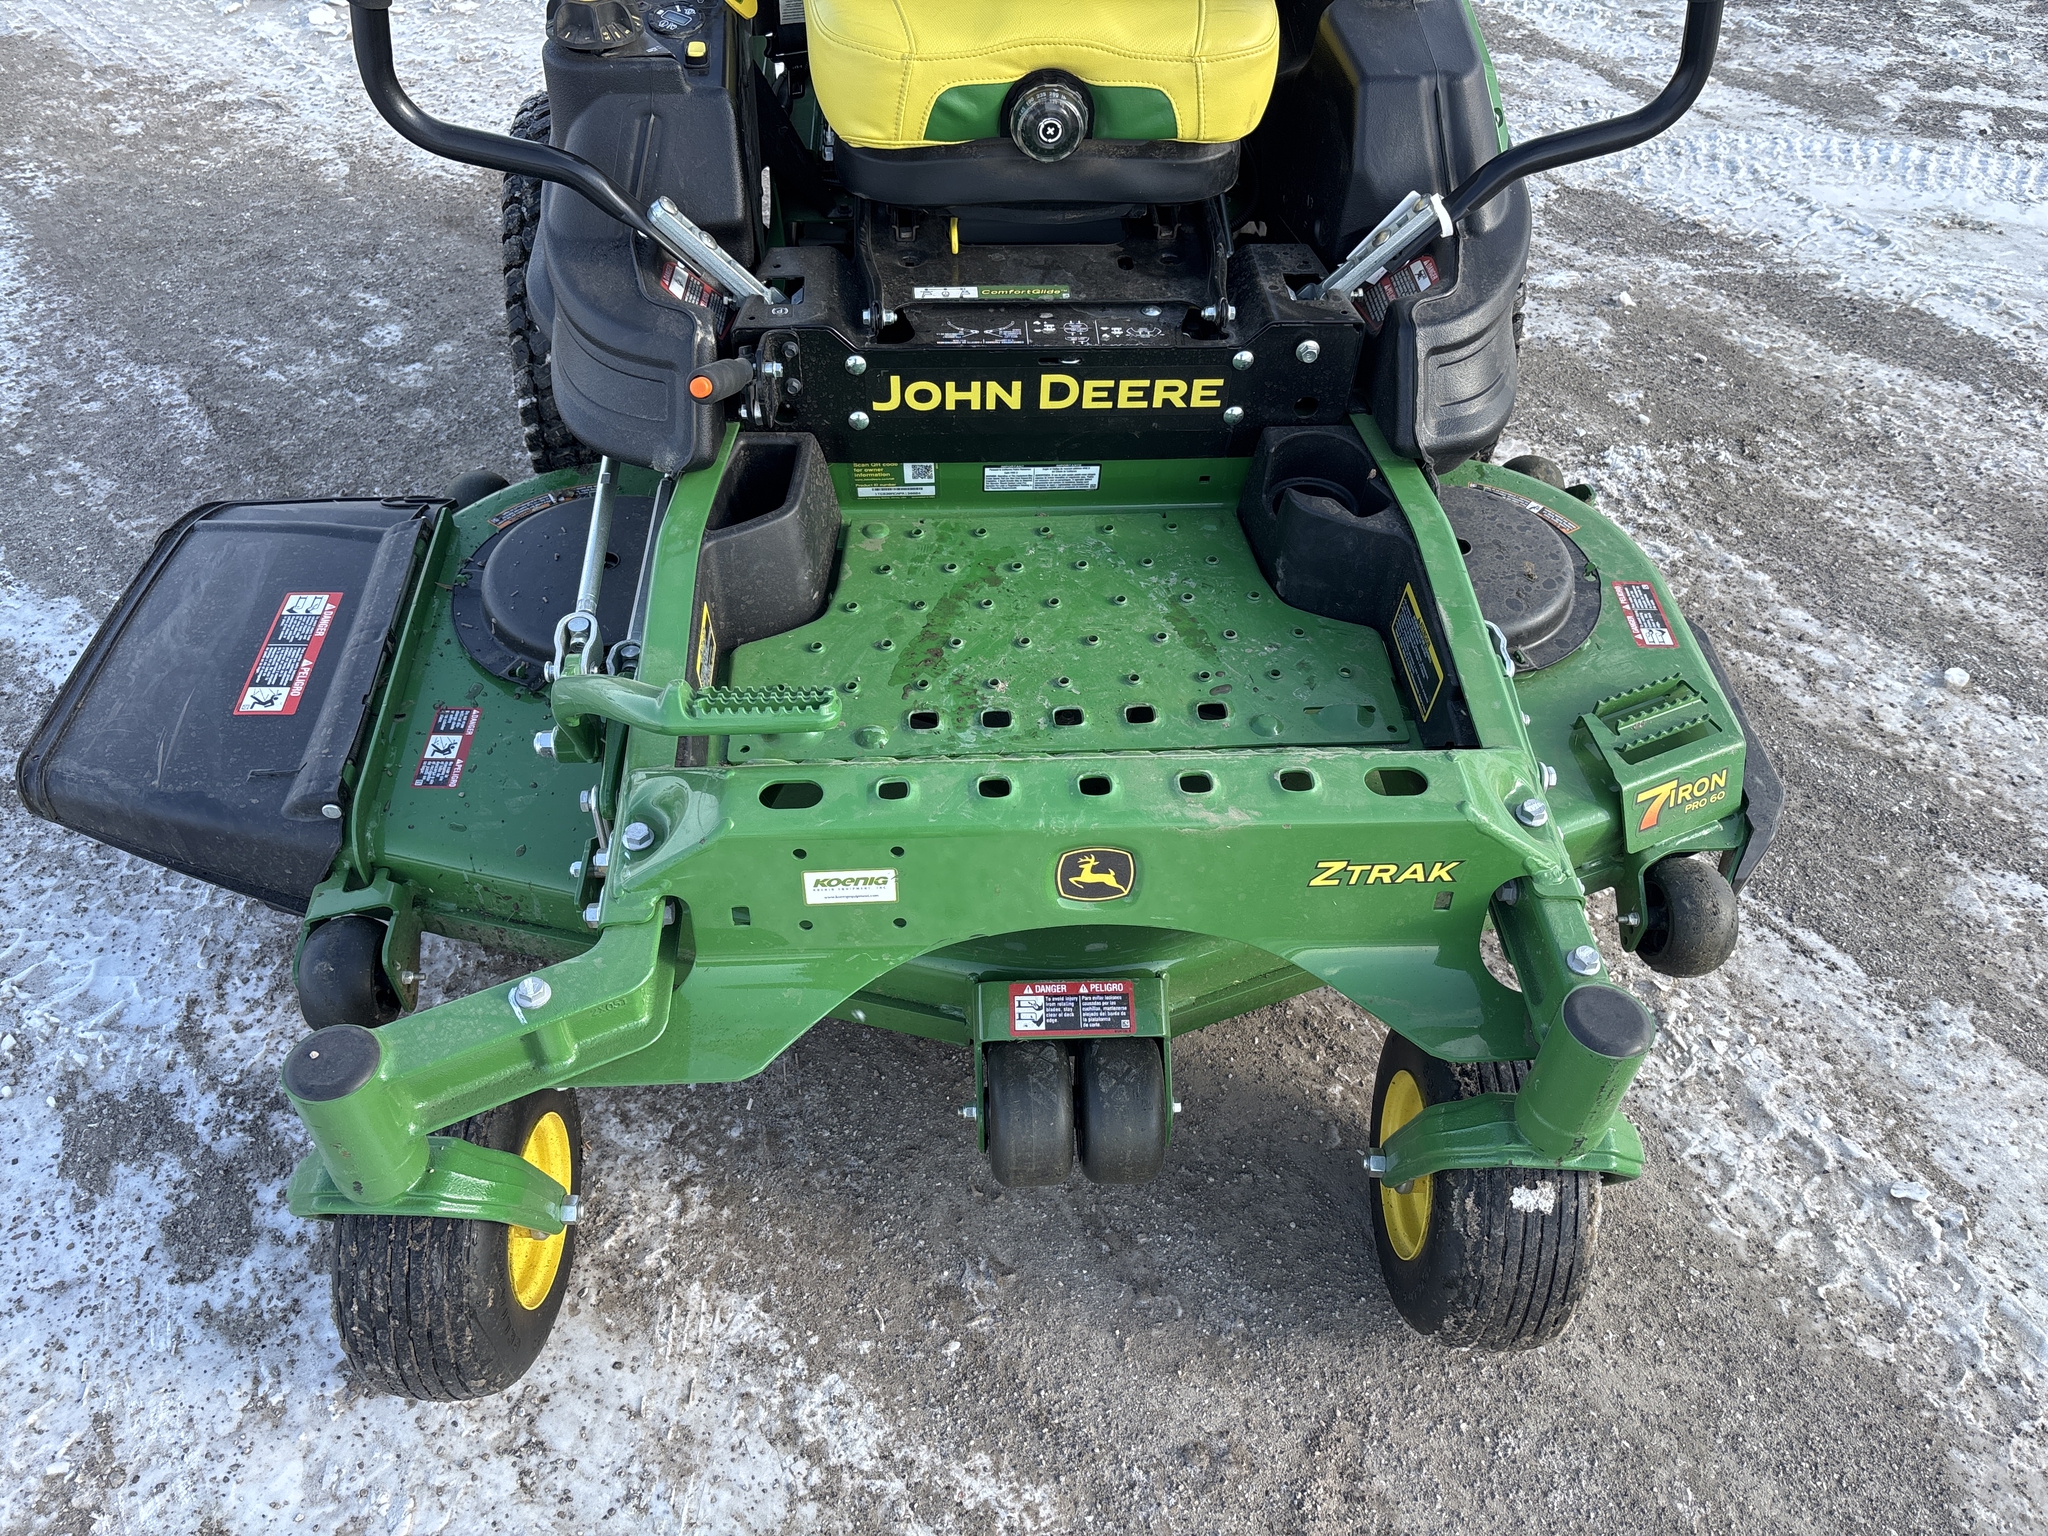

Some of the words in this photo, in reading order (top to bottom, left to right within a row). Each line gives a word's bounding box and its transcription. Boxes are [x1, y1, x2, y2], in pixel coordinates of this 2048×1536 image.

[872, 375, 1022, 411] JOHN
[1039, 374, 1225, 409] DEERE
[314, 611, 333, 636] DANGER
[290, 667, 310, 697] PELIGRO
[466, 713, 479, 735] DANGER
[449, 763, 462, 787] PELIGRO
[1684, 798, 1707, 814] PRO
[1710, 790, 1726, 803] 60
[1306, 860, 1466, 887] ZTRAK
[1035, 984, 1067, 993] DANGER
[1090, 983, 1124, 992] PELIGRO
